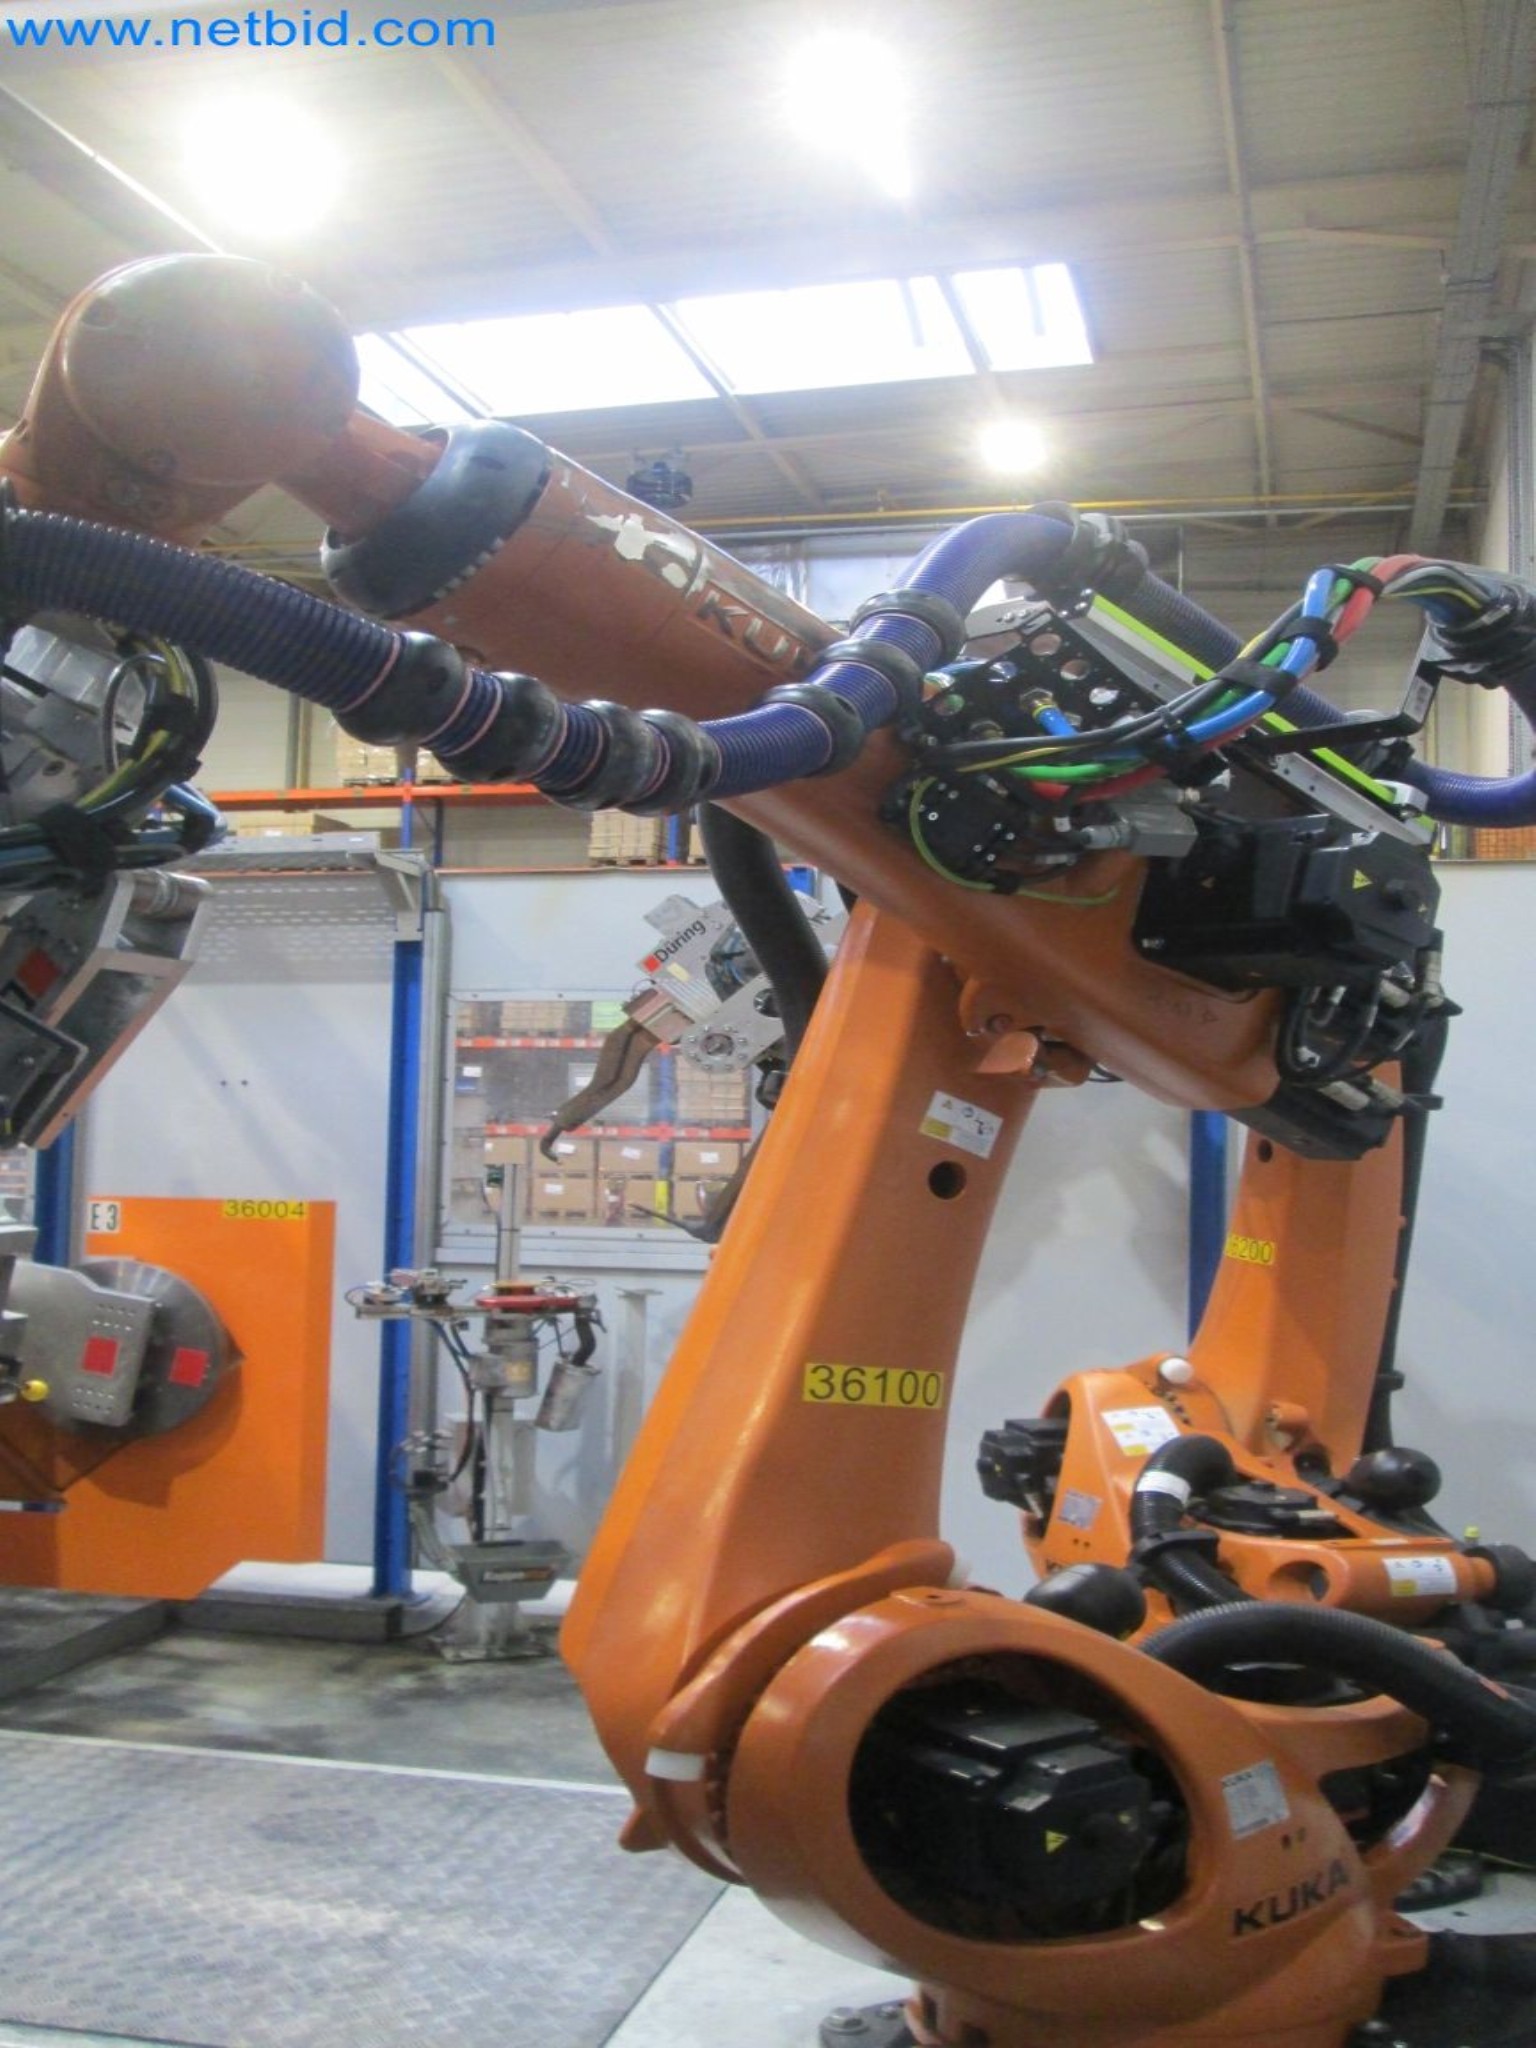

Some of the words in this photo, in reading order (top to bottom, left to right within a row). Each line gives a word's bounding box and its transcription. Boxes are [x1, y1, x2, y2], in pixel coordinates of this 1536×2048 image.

[224, 1198, 305, 1218] 36004
[809, 1364, 941, 1406] 36100
[1233, 1858, 1349, 1936] KUKA
